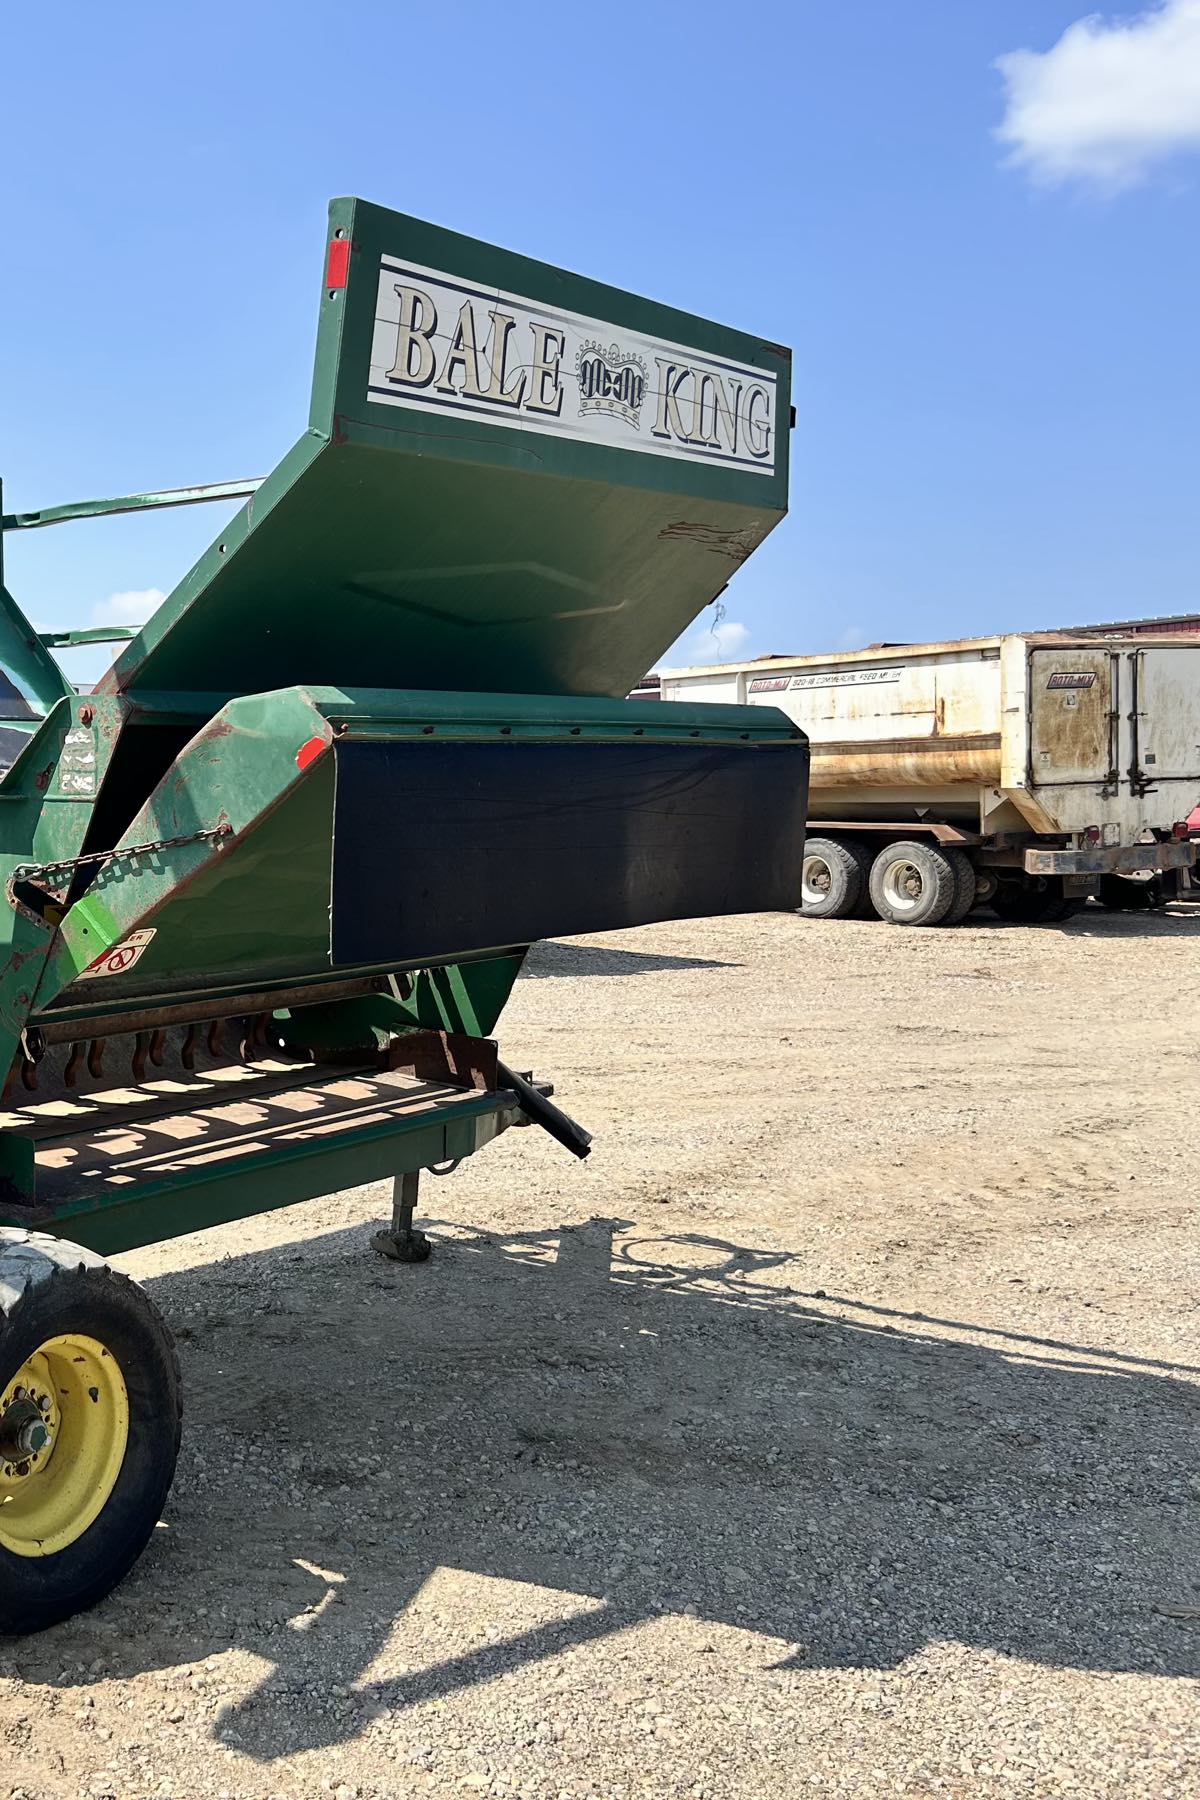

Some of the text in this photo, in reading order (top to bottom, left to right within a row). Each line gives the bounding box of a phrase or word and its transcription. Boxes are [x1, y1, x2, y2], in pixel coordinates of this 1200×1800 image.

[384, 283, 771, 458] BALE KING
[751, 678, 789, 690] ROTO-MIX
[1049, 674, 1094, 687] ROTO-MIX
